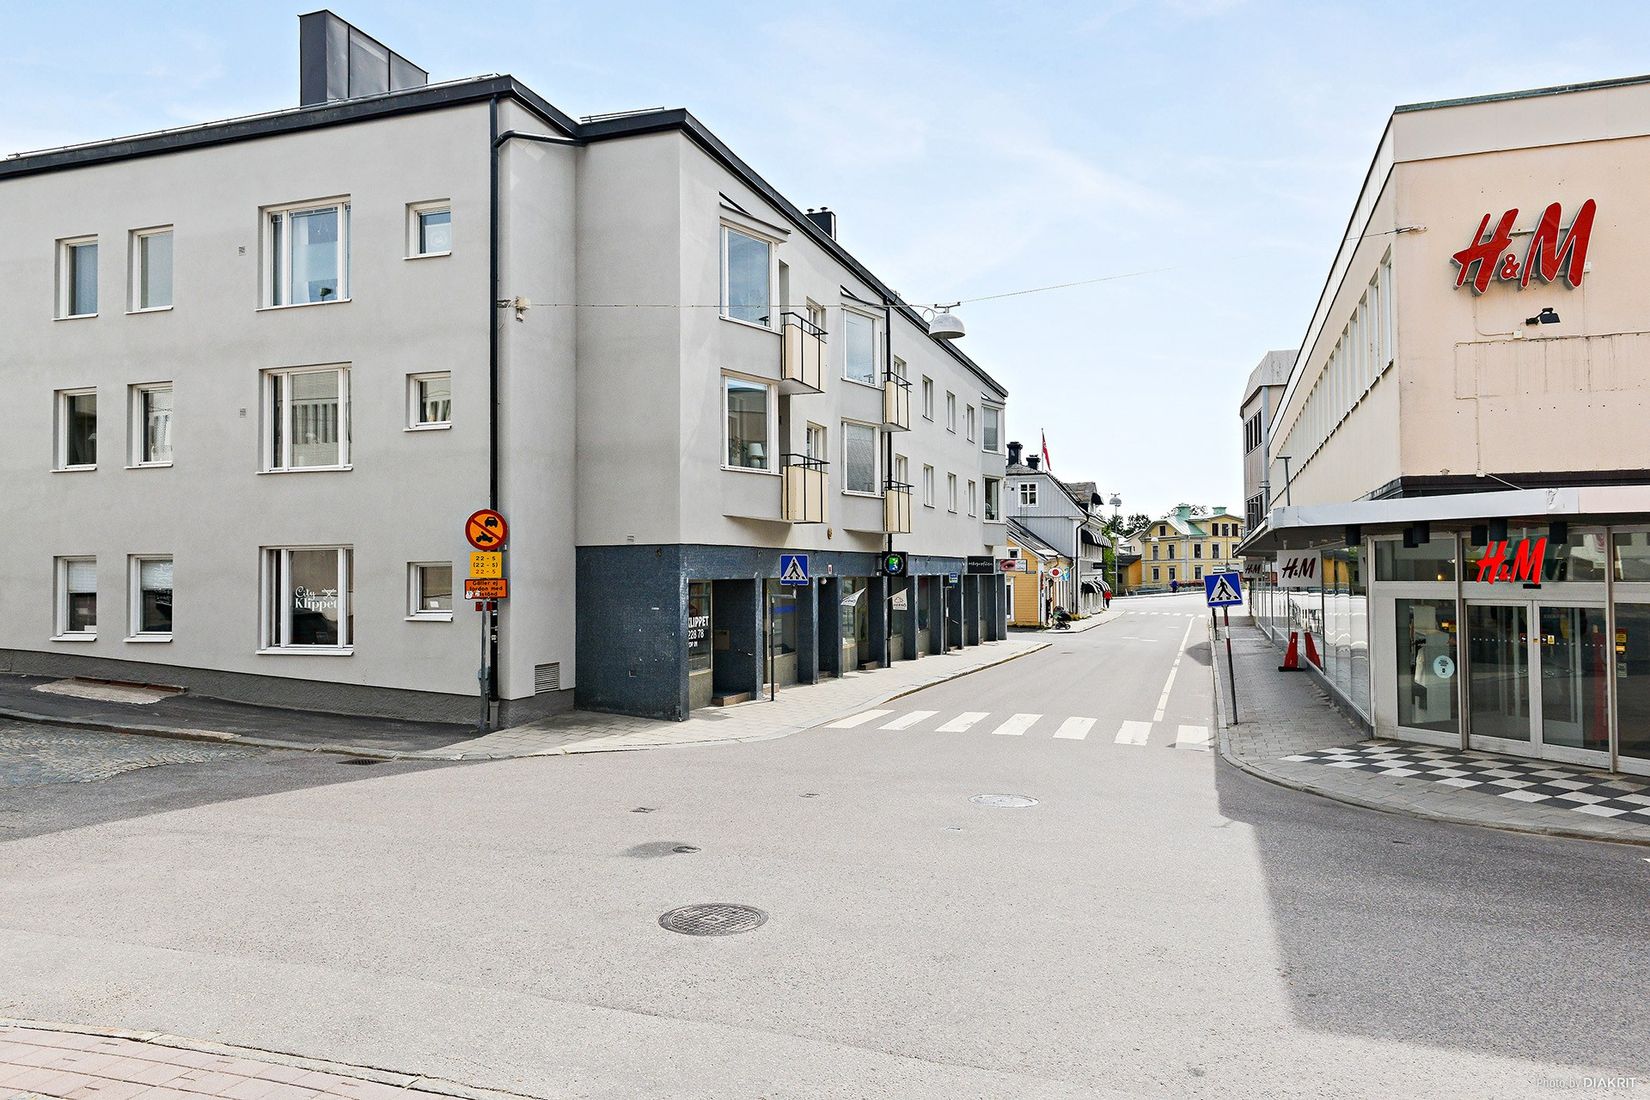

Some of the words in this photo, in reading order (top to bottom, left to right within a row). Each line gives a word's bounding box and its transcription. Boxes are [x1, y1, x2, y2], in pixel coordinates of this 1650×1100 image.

[1452, 198, 1597, 294] H&M
[1244, 563, 1261, 574] H&M
[1281, 557, 1317, 579] H&M
[1476, 536, 1548, 585] H&M
[295, 585, 317, 600] City
